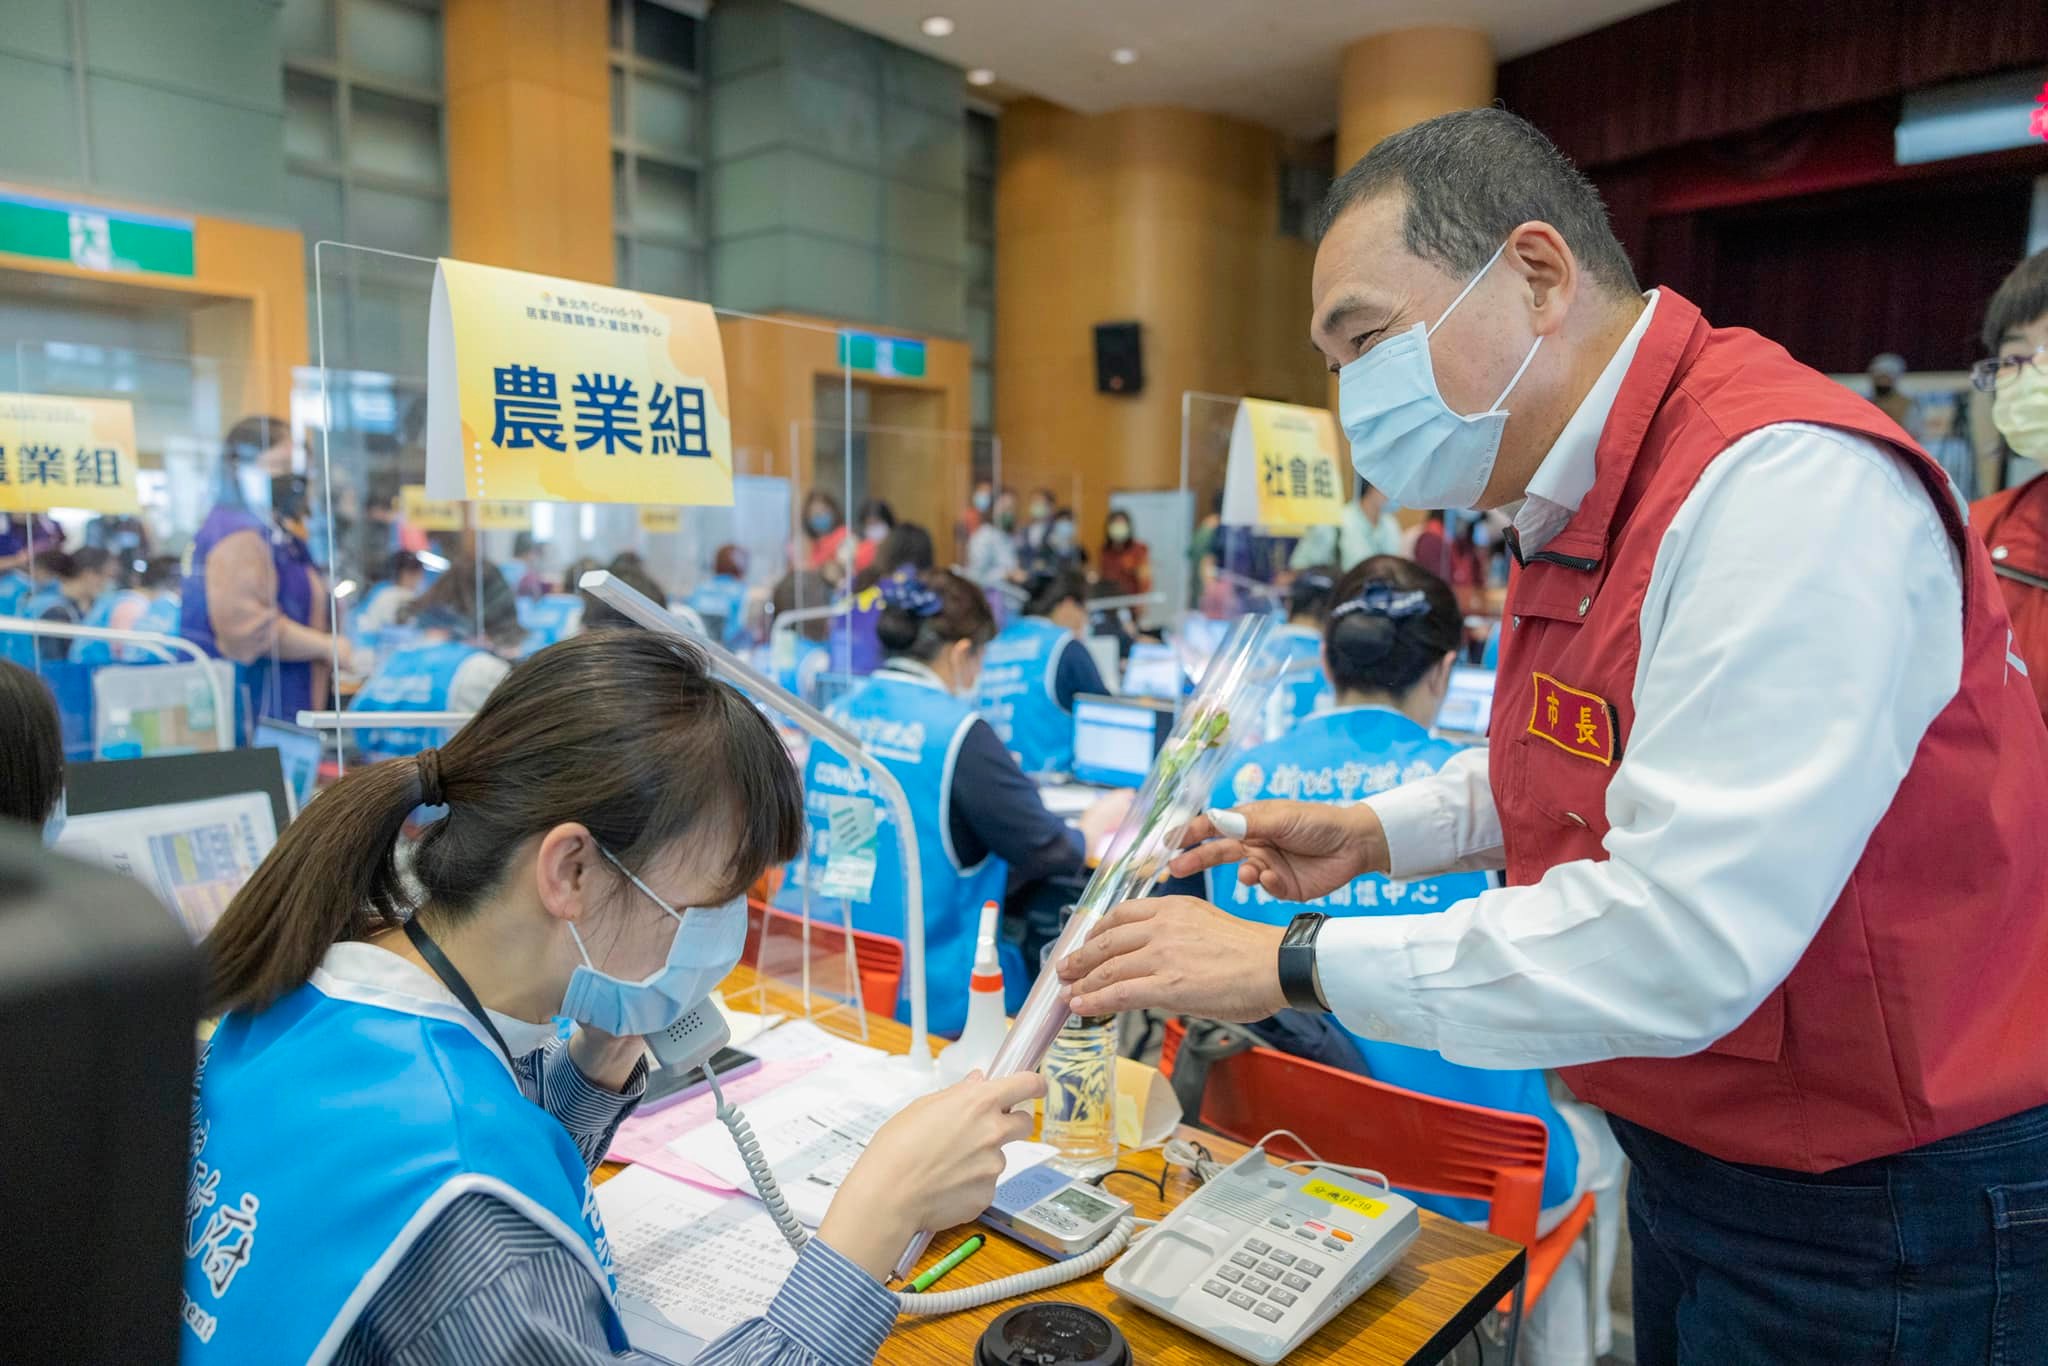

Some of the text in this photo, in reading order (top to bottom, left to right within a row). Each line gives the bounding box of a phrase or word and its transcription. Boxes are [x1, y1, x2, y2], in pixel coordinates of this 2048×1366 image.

[491, 364, 712, 459] 農業組
[1263, 455, 1334, 499] 社會組
[1546, 690, 1601, 748] 市長
